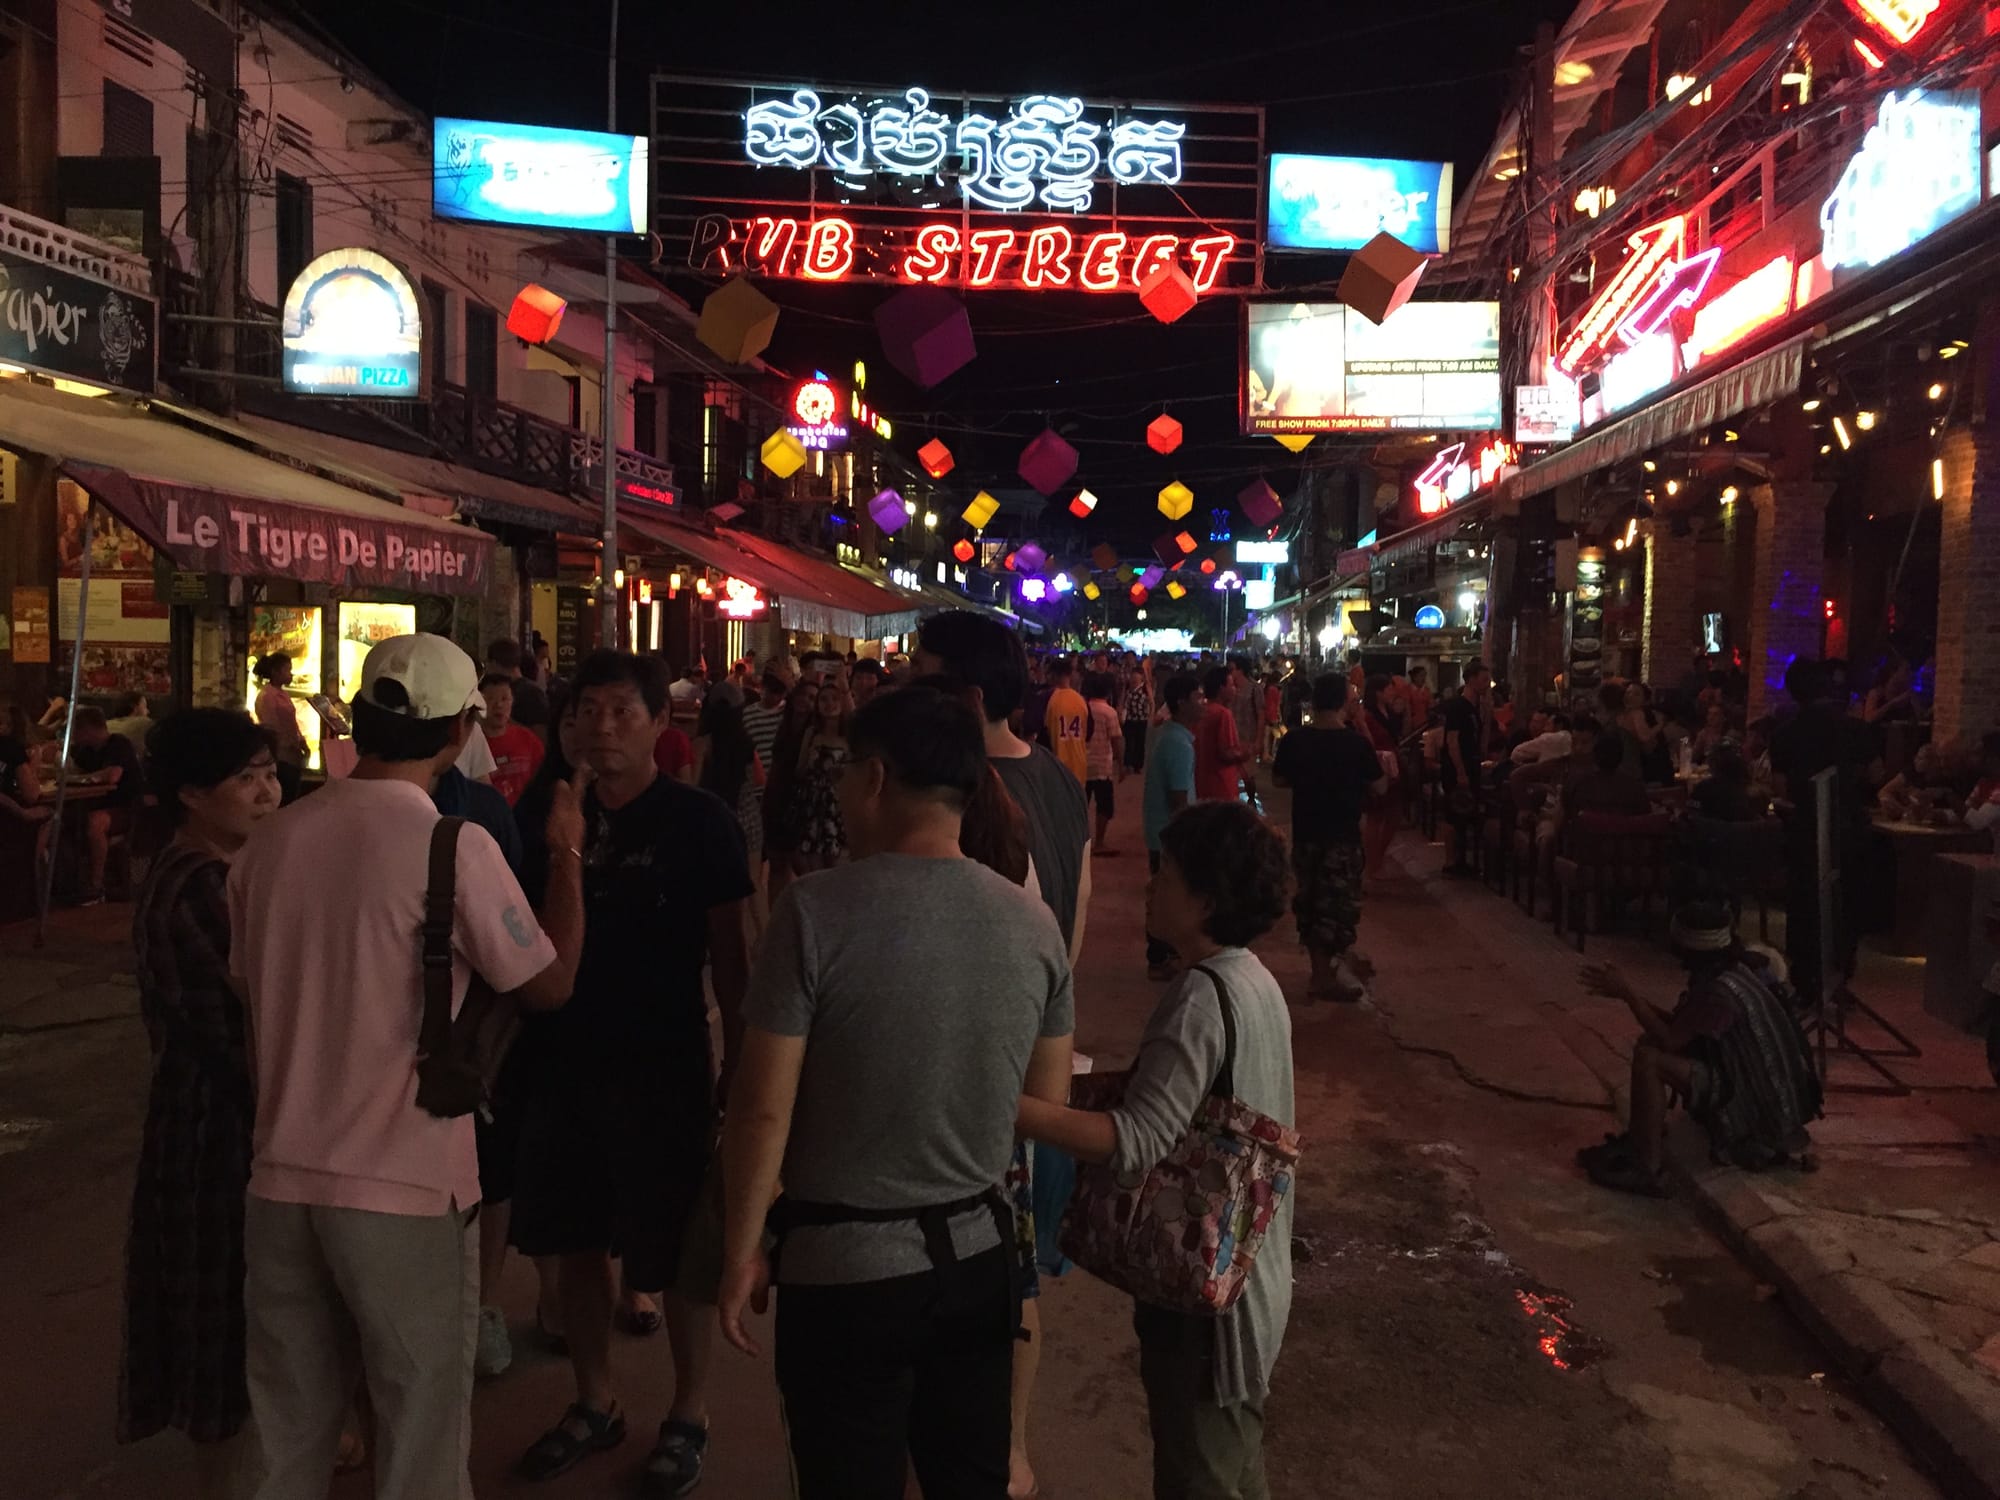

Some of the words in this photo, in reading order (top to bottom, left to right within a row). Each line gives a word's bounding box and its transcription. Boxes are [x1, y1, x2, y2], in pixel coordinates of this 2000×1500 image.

[904, 223, 1236, 293] STREET
[361, 366, 409, 388] PIZZA
[1417, 361, 1441, 372] FROM
[1459, 361, 1473, 371] AM
[1255, 419, 1277, 429] FREE
[1278, 419, 1304, 428] SHOW
[1305, 418, 1330, 428] FROM
[166, 499, 220, 549] Le
[230, 510, 328, 568] Tigre
[338, 527, 377, 569] De
[386, 534, 467, 582] Papier
[1058, 714, 1081, 739] 14
